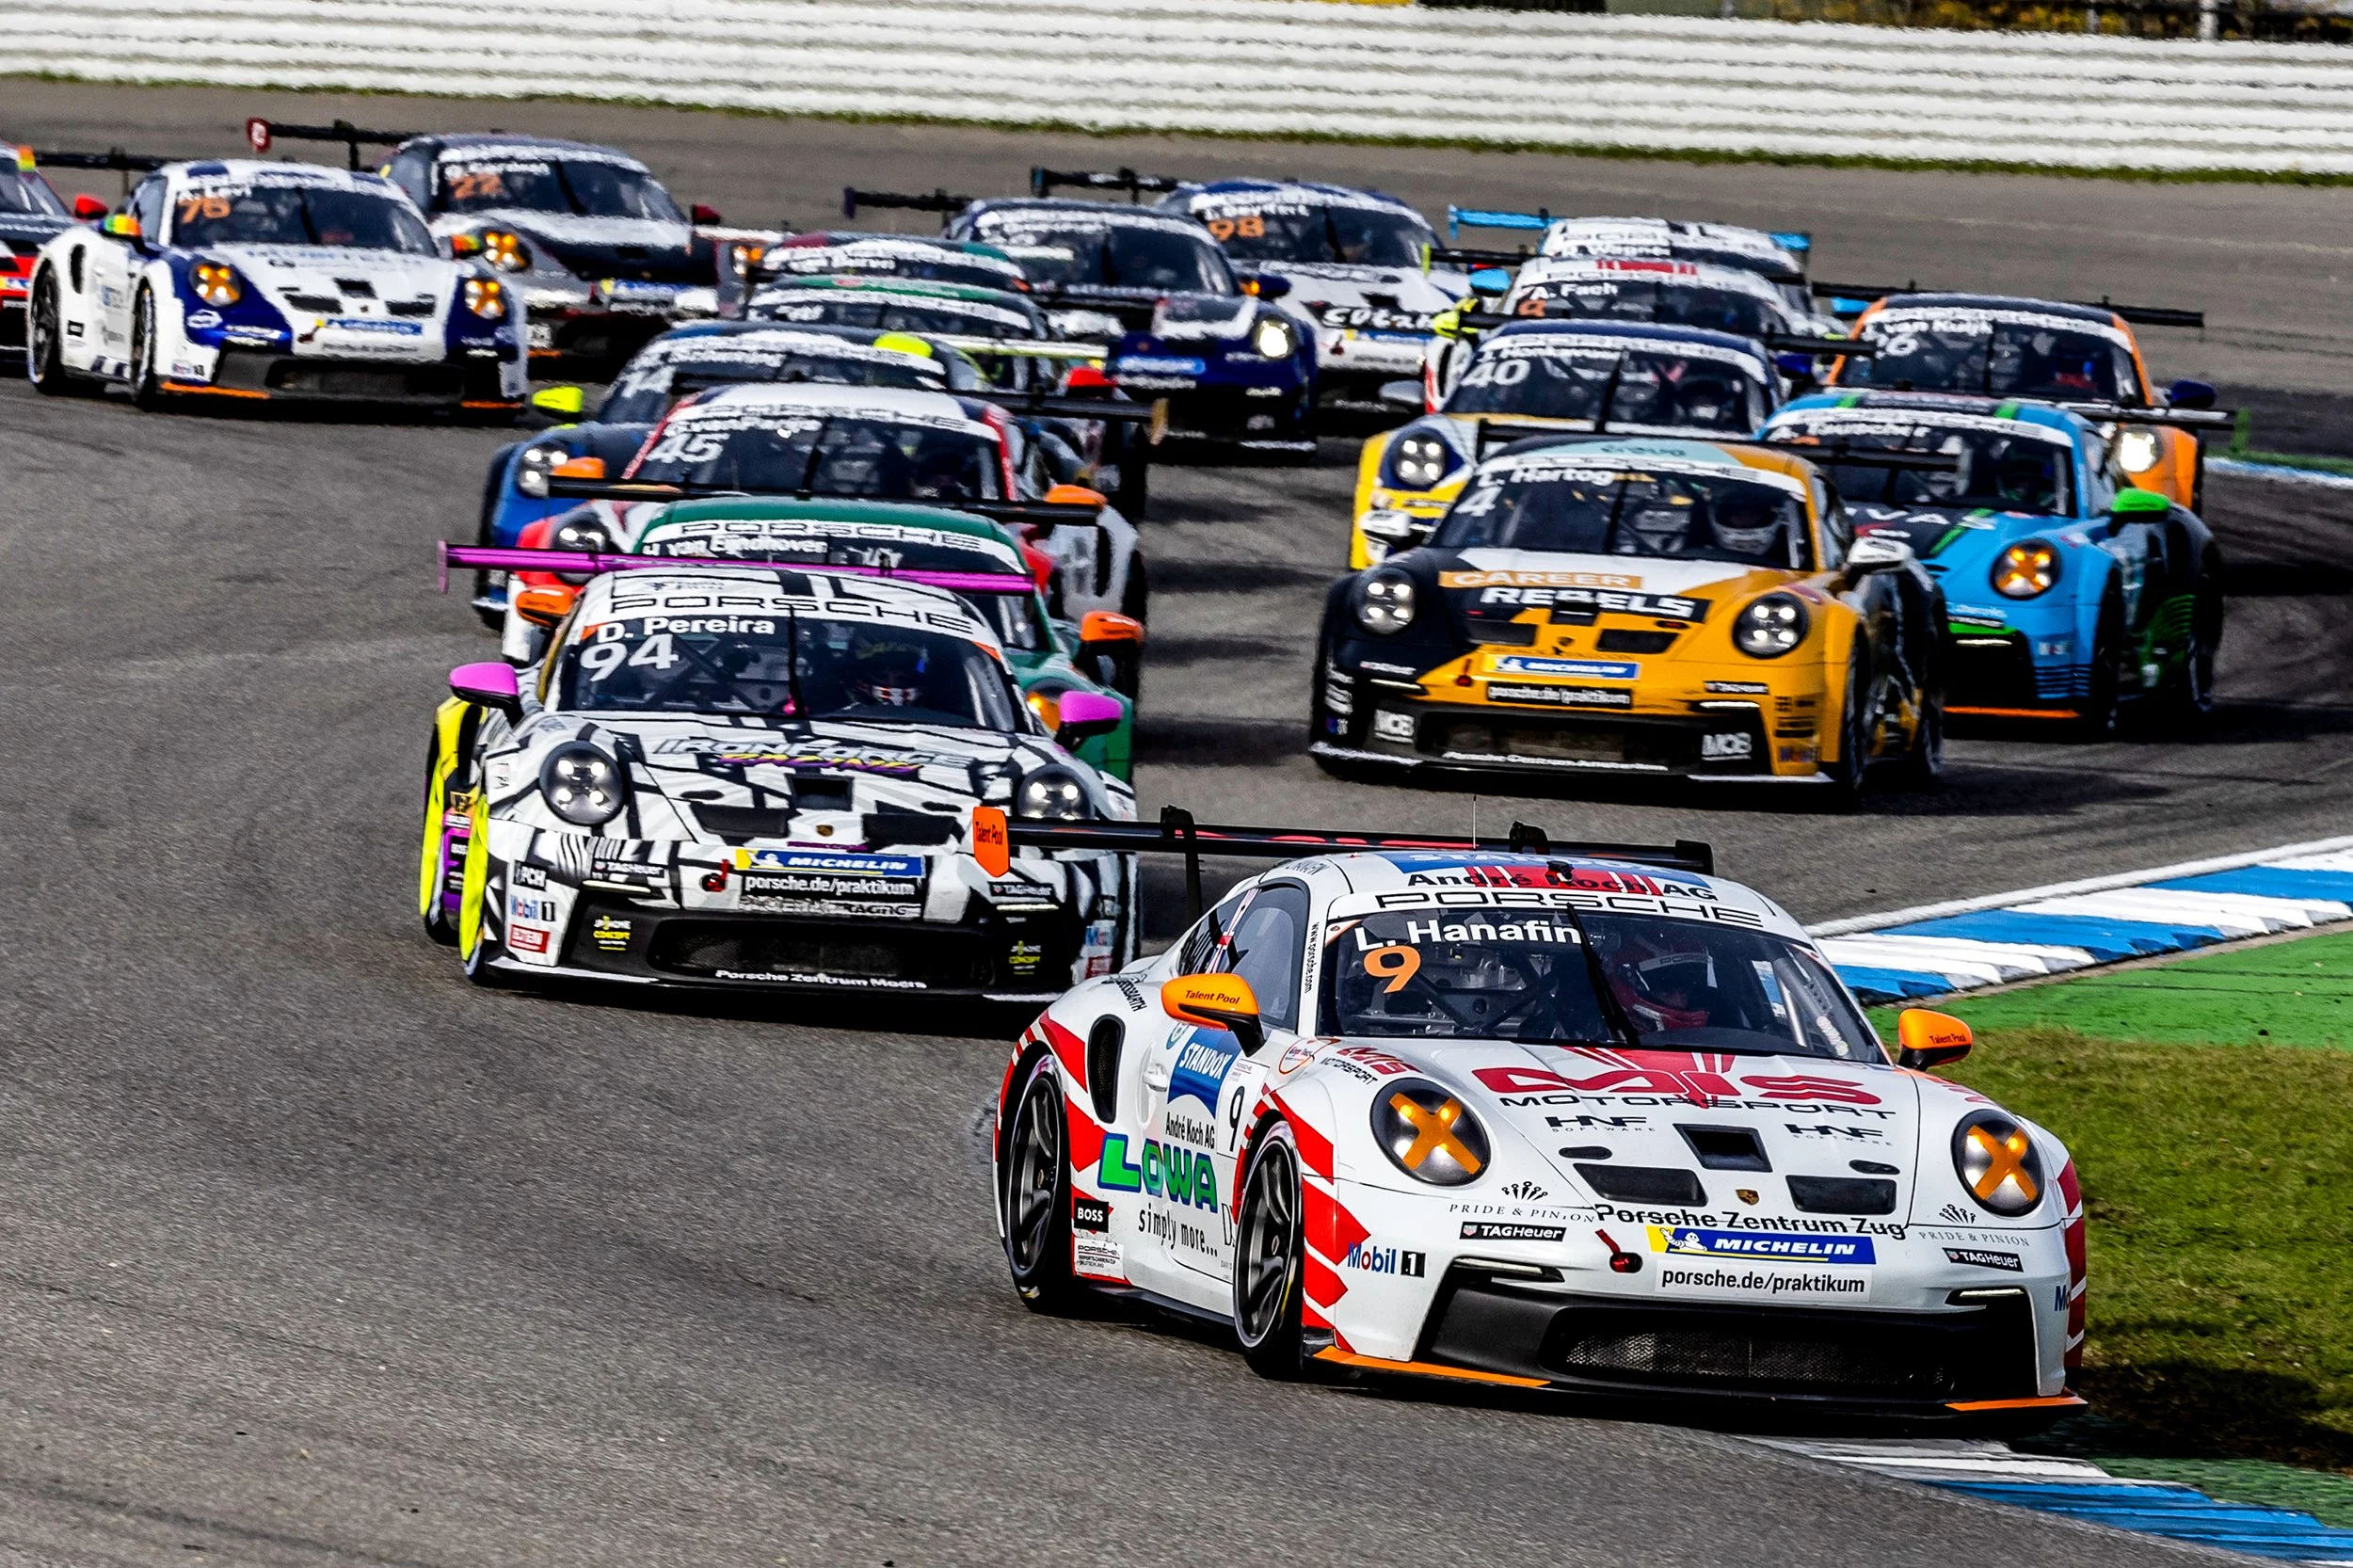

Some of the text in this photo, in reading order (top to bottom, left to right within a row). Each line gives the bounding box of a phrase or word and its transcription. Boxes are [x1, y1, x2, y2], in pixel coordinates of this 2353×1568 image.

[1561, 282, 1619, 296] Fach
[1460, 359, 1530, 387] 40
[645, 433, 729, 463] 45
[1510, 468, 1615, 488] Hartog
[1453, 488, 1503, 517] 4
[681, 521, 981, 550] PORSCHE
[1452, 571, 1629, 588] CAREER
[610, 595, 973, 636] PORSCHE
[1480, 585, 1694, 618] REBELS
[597, 616, 776, 644] D. Pereira
[580, 633, 680, 682] 94
[975, 821, 1004, 845] Talent Pool
[788, 856, 908, 871] MICHELIN
[744, 875, 916, 896] porsche.de/praktikum
[1408, 873, 1719, 902] André Koch AG
[542, 902, 555, 921] 1
[1377, 891, 1764, 928] PORSCHE
[1354, 920, 1582, 951] L. Hanafin
[1305, 921, 1321, 994] www.porsche.com
[1363, 945, 1421, 994] 9
[715, 970, 928, 989] Porsche Zentrum Moers
[1185, 988, 1241, 1004] Talent Pool
[1929, 1034, 1951, 1044] Talent
[1178, 1042, 1233, 1080] STANDOX
[1320, 1056, 1379, 1085] MOTORSPORT
[1228, 1085, 1246, 1153] 9
[1499, 1096, 1897, 1120] MOTORSPORT
[1546, 1115, 1648, 1128] HNF
[1165, 1112, 1216, 1150] André Koch AG
[1784, 1123, 1884, 1138] HNF
[1793, 1135, 1893, 1146] SOFTWARE
[1096, 1131, 1219, 1213] LOWA
[1077, 1207, 1104, 1224] BOSS
[1449, 1203, 1596, 1224] PRIDE & PINION
[1597, 1203, 1906, 1240] Porsche Zentrum Zug
[1138, 1202, 1218, 1257] simply more...
[1918, 1230, 2030, 1247] PRIDE & PINION
[1347, 1241, 1423, 1277] Mobil 1
[1714, 1238, 1857, 1256] MICHELIN
[1660, 1269, 1865, 1294] porsche.de/praktikum
